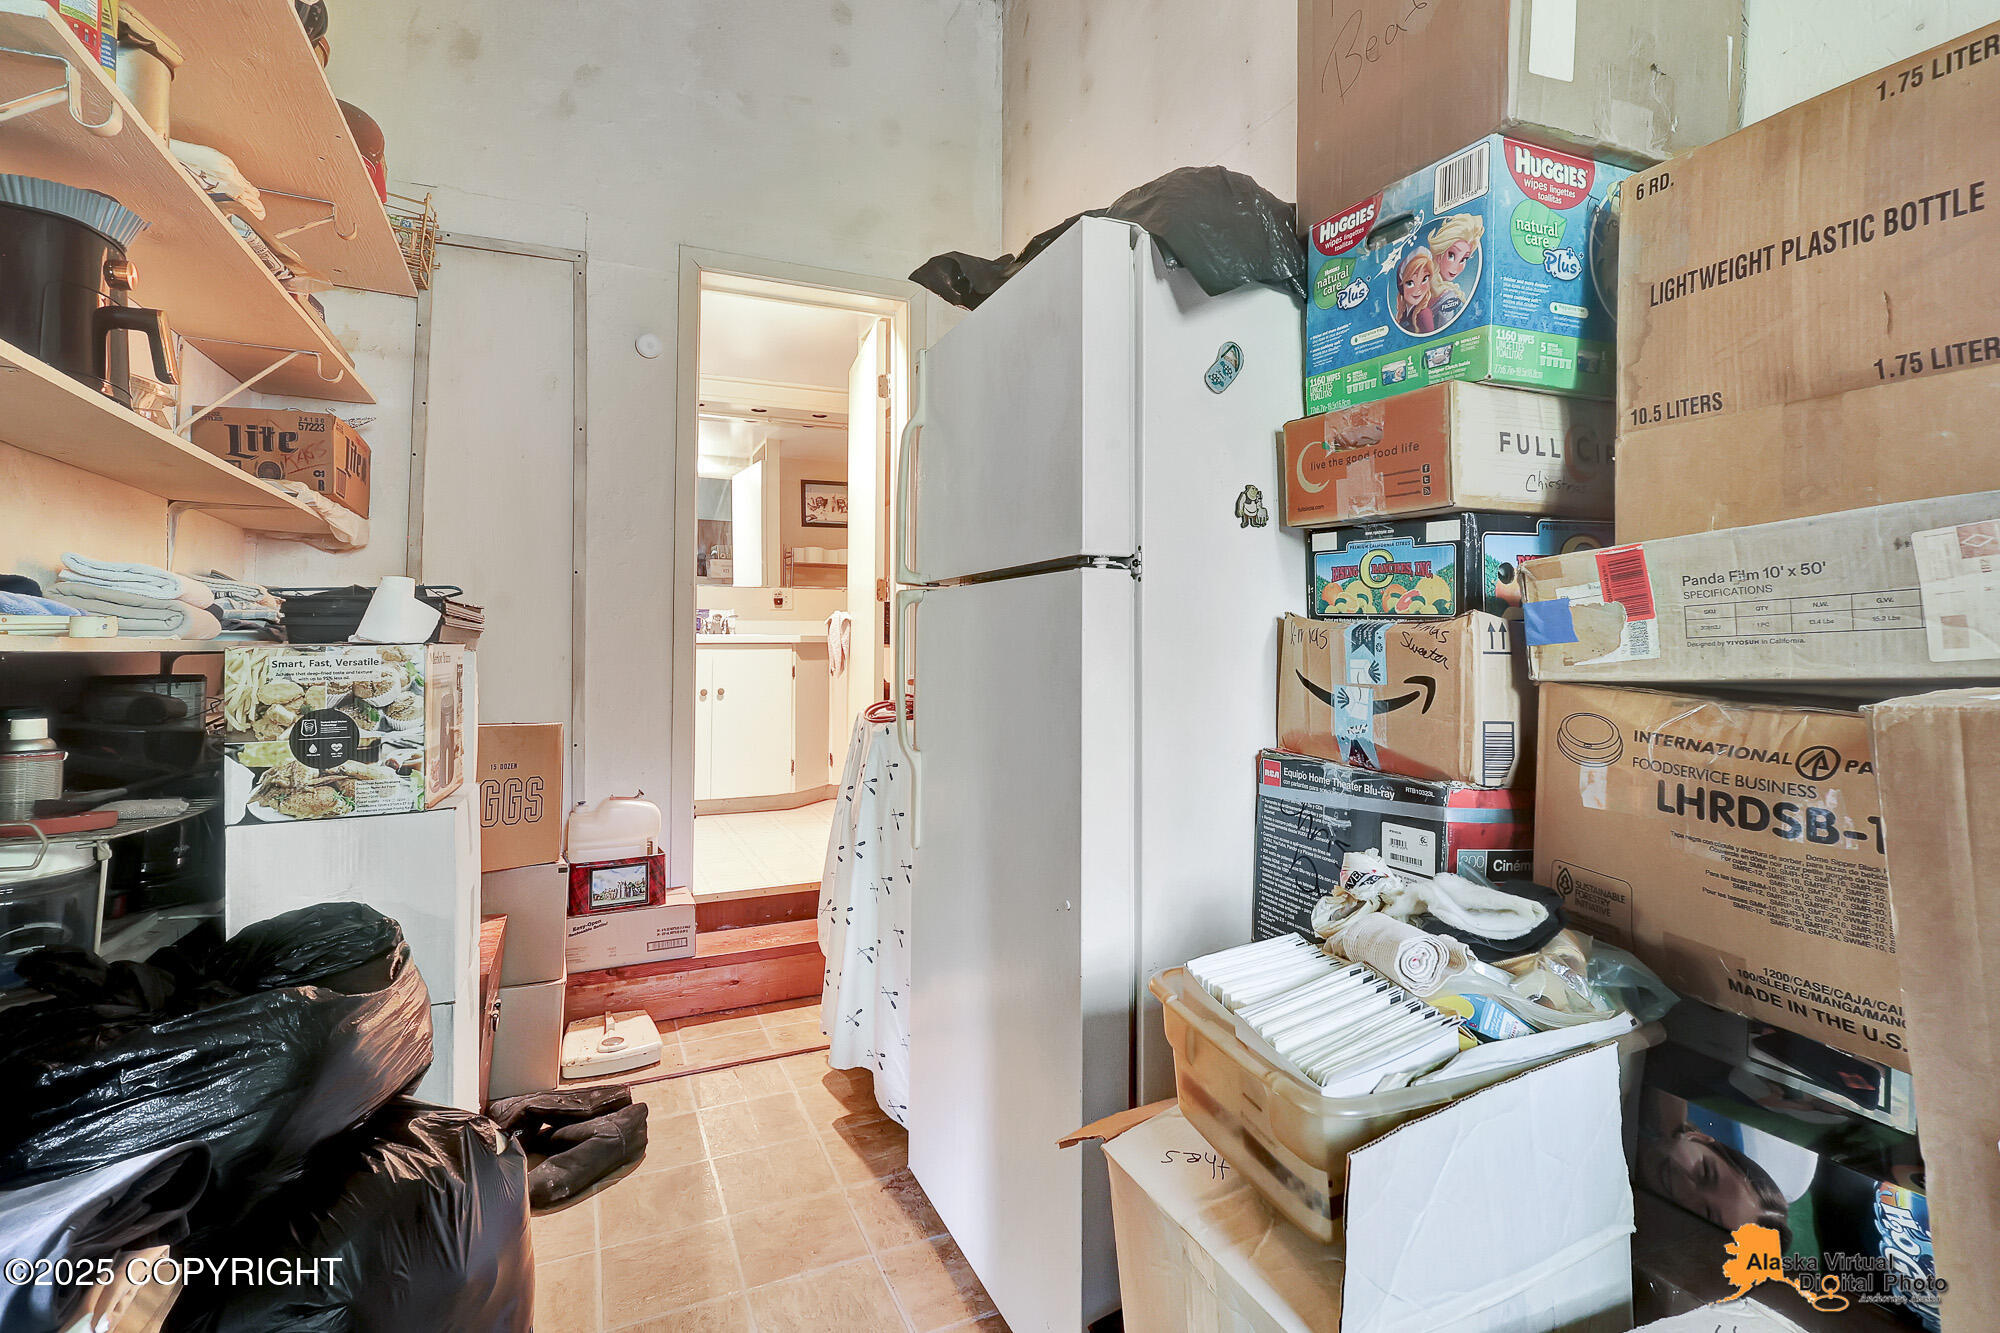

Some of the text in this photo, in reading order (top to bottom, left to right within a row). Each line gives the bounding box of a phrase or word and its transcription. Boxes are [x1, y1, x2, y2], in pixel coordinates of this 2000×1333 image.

[1875, 65, 1925, 102] 1.75
[1514, 146, 1587, 189] HUGGIES
[1524, 178, 1576, 198] wipes lingettes
[1636, 172, 1674, 200] 6 RD.
[1538, 192, 1562, 204] toallitas
[1319, 204, 1375, 244] HUGGIES
[1516, 219, 1558, 238] natural
[1325, 226, 1364, 249] wipes lingettes
[1525, 233, 1550, 248] care
[1650, 180, 1985, 308] LIGHTWEIGHT PLASTIC BOTTLE
[1544, 252, 1577, 274] Plus
[1317, 265, 1349, 289] natural
[1323, 282, 1342, 296] care
[1338, 286, 1366, 304] Plus
[1496, 329, 1516, 342] 1160
[1540, 342, 1546, 352] 5
[1872, 350, 1924, 381] 1.75
[1310, 375, 1326, 386] 1160
[1326, 372, 1341, 382] WIPES
[1346, 374, 1352, 383] 5
[1630, 392, 1723, 426] 10.5 LITERS
[298, 422, 325, 432] 57223
[224, 424, 299, 460] Lite
[1500, 432, 1561, 458] FULL
[345, 436, 361, 479] Lite
[1310, 442, 1420, 472] live the good food life
[1332, 565, 1358, 582] RISING
[1371, 562, 1414, 580] RANCHES,
[1682, 561, 1826, 586] Panda Film 10' x 50'
[1683, 584, 1773, 600] SPECIFICATIONS
[1876, 596, 1894, 604] G.W.
[1686, 640, 1716, 648] Designed
[1717, 640, 1725, 648] by
[272, 658, 380, 668] Smart, Fast, Versatile
[1633, 729, 1793, 766] INTERNATIONAL
[500, 762, 518, 770] DOZEN
[1264, 768, 1281, 780] RCA
[1283, 766, 1396, 801] Equipo Home Theater Blu-ray
[1632, 756, 1818, 800] FOODSERVICE BUSINESS
[1705, 870, 1720, 878] Para
[1770, 860, 1782, 868] noir
[1784, 864, 1801, 872] pour
[1854, 876, 1866, 884] de
[1806, 854, 1882, 873] Dome Sipper Black
[1806, 862, 1824, 870] para
[1848, 868, 1859, 876] de
[1732, 858, 1748, 867] cups
[1749, 858, 1777, 872] SMM-10,
[1780, 868, 1812, 881] SMR-12,
[1814, 875, 1848, 888] SMR-16,
[1850, 882, 1886, 896] SMR-20,
[1732, 864, 1888, 902] SMRE-12, SMRE-16, SMRE-20, SMRP-12,
[1576, 880, 1626, 904] SUSTAINABLE
[1576, 889, 1611, 908] FORESTRY
[1769, 880, 1887, 910] SMRP-20, SMT-24, SWME-10,
[1575, 898, 1612, 918] INITIATIVE
[1728, 978, 1784, 1008] MADE
[1788, 1000, 1809, 1018] IN
[1812, 1008, 1857, 1035] THE
